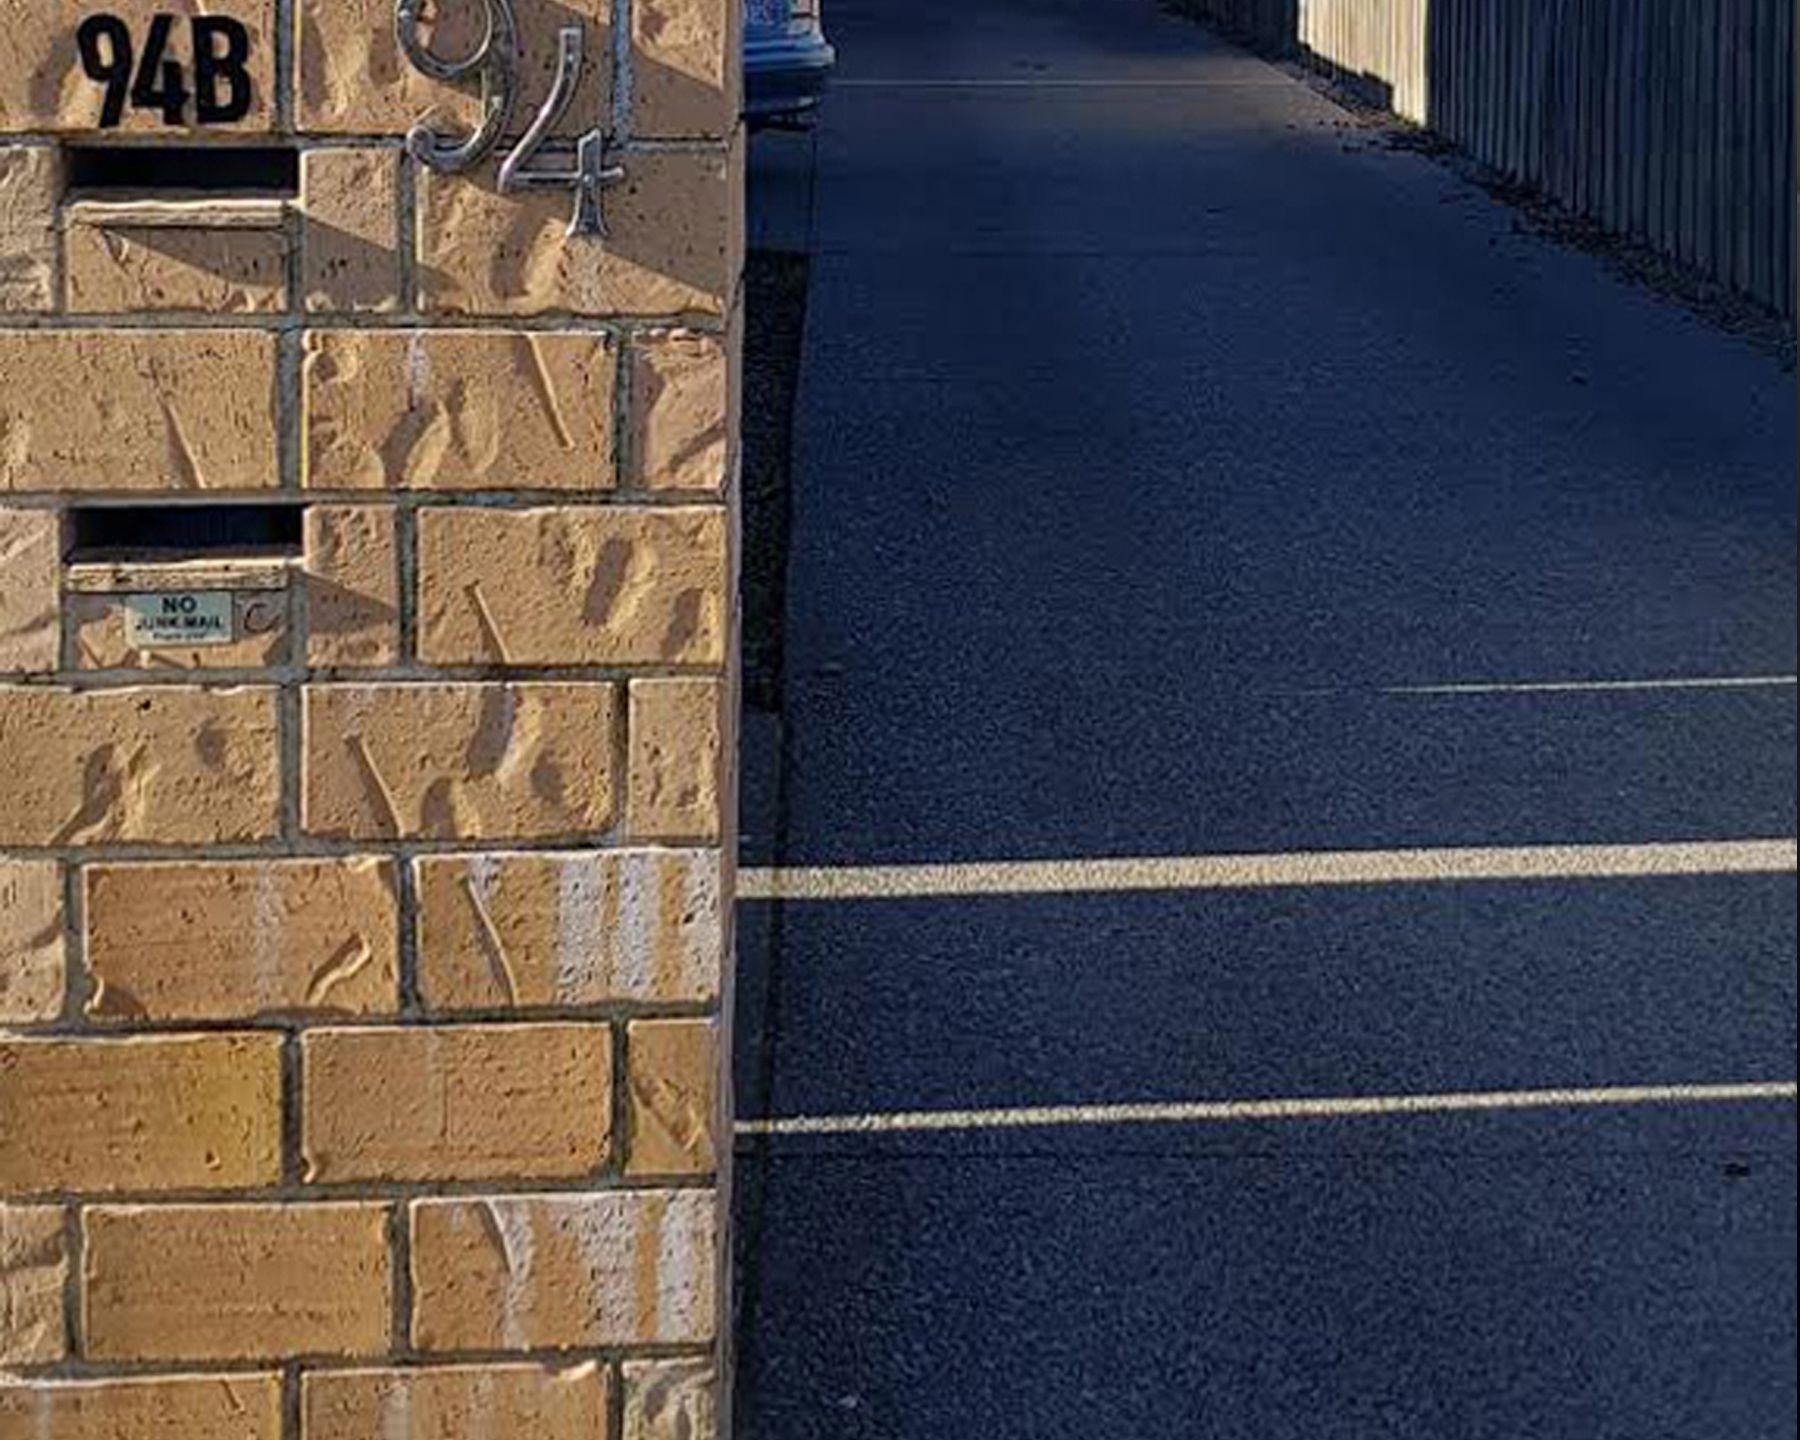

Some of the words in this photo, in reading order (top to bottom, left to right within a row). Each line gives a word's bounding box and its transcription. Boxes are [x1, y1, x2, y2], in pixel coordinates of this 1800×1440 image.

[77, 13, 251, 128] 94B
[162, 596, 197, 613] NO
[136, 617, 178, 631] JUNK
[183, 616, 223, 630] MAIL
